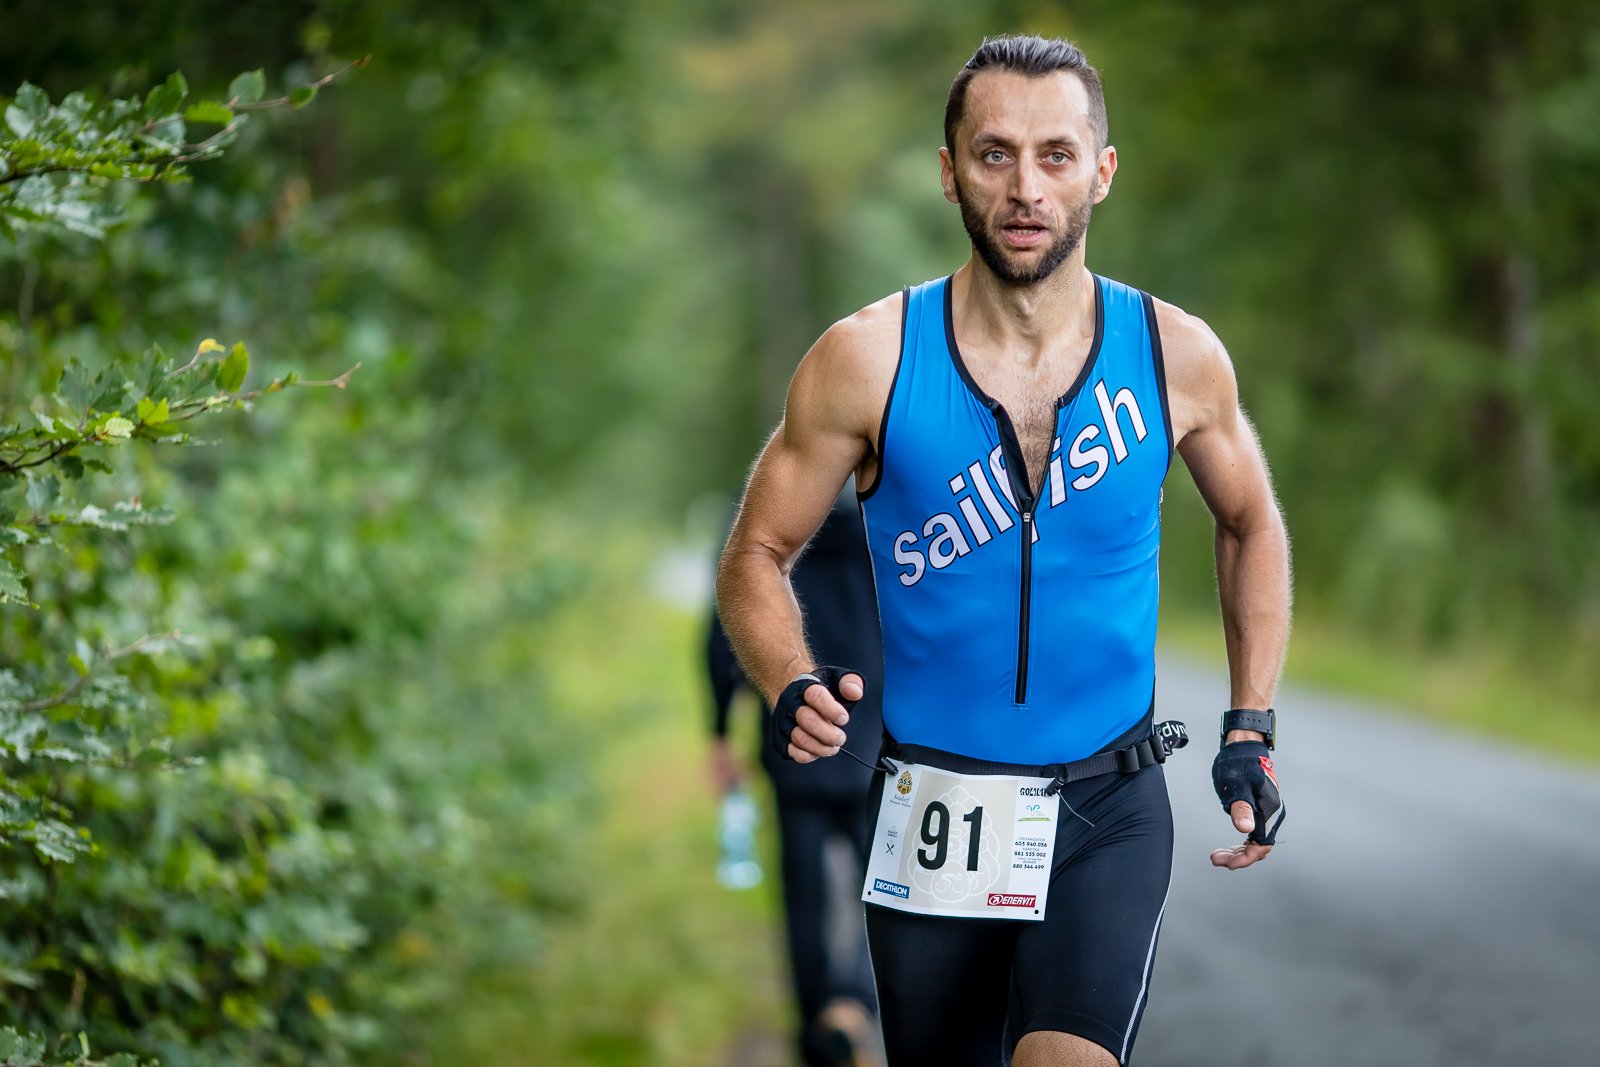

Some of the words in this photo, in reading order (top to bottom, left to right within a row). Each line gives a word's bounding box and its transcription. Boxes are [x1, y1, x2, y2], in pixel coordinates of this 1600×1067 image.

[917, 800, 984, 872] 91
[875, 880, 908, 896] DECATHLON
[1002, 895, 1036, 906] ENERVIT
